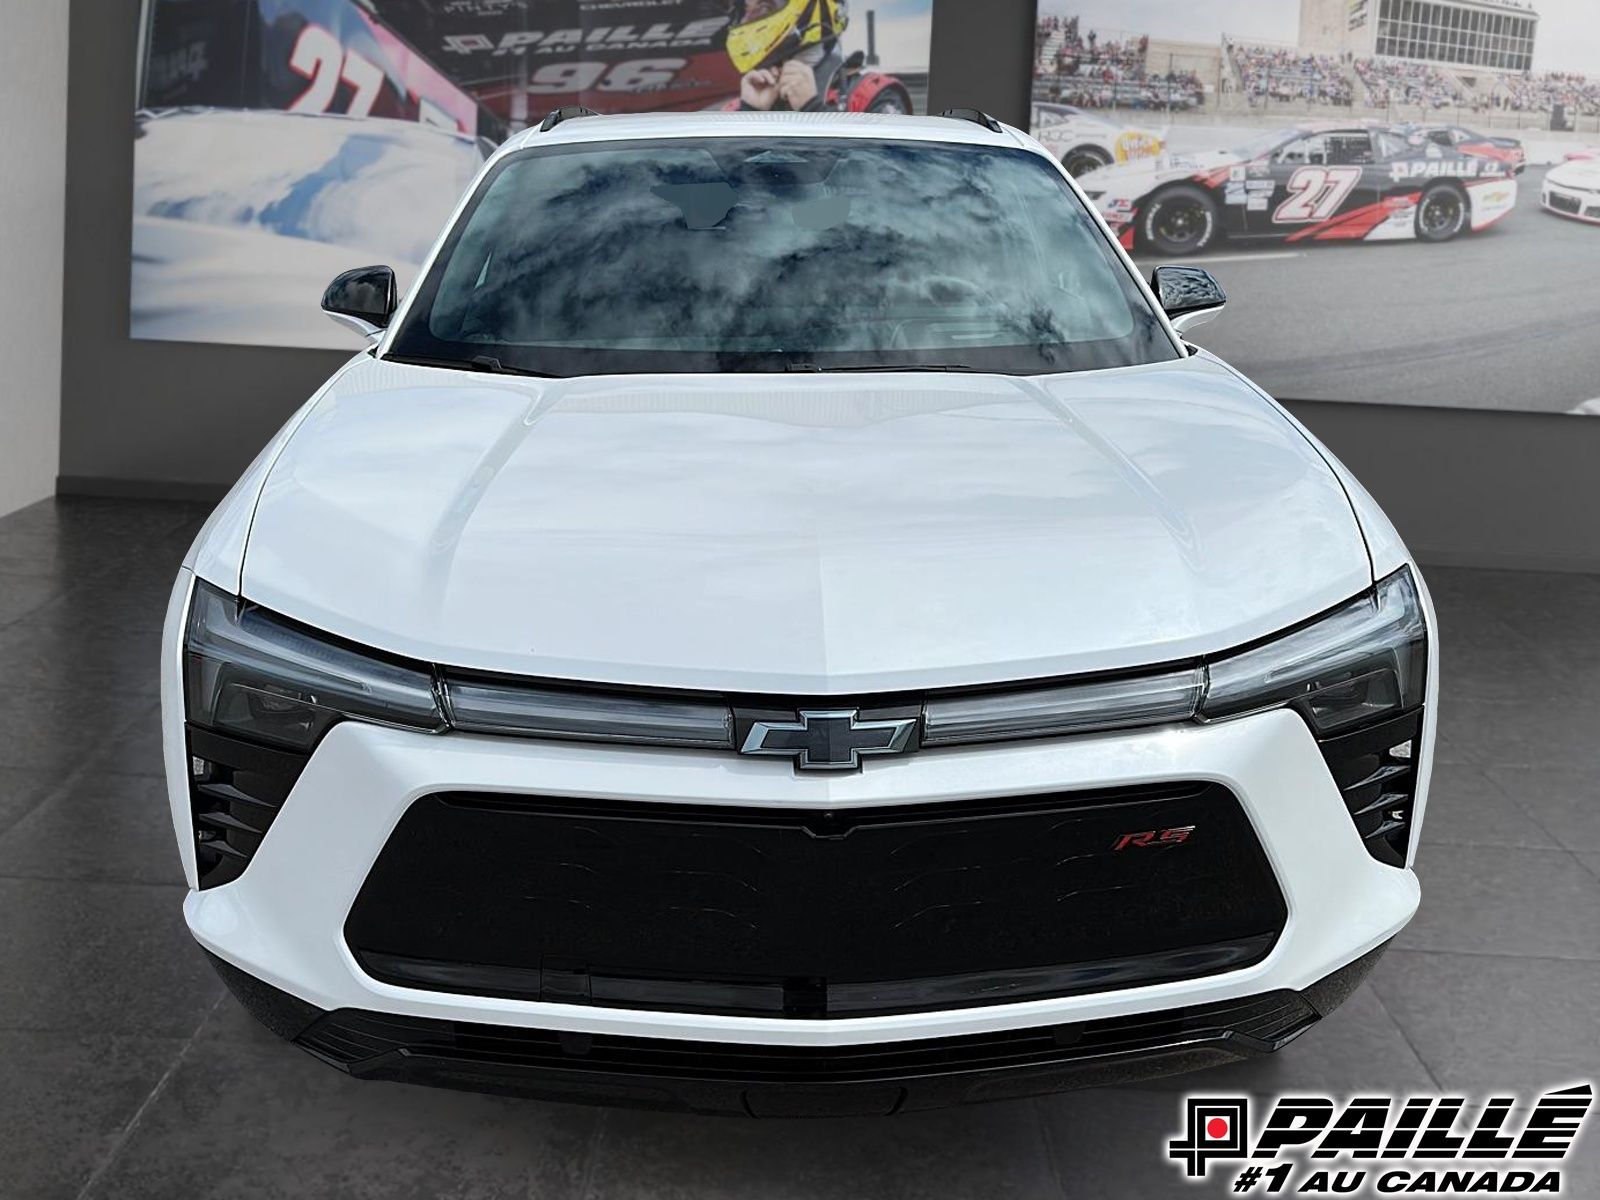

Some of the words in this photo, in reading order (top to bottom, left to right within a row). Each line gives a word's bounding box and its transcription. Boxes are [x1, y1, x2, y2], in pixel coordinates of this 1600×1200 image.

[286, 23, 385, 119] 27
[526, 58, 688, 94] 96
[1271, 165, 1363, 223] 27
[1110, 825, 1196, 851] RS
